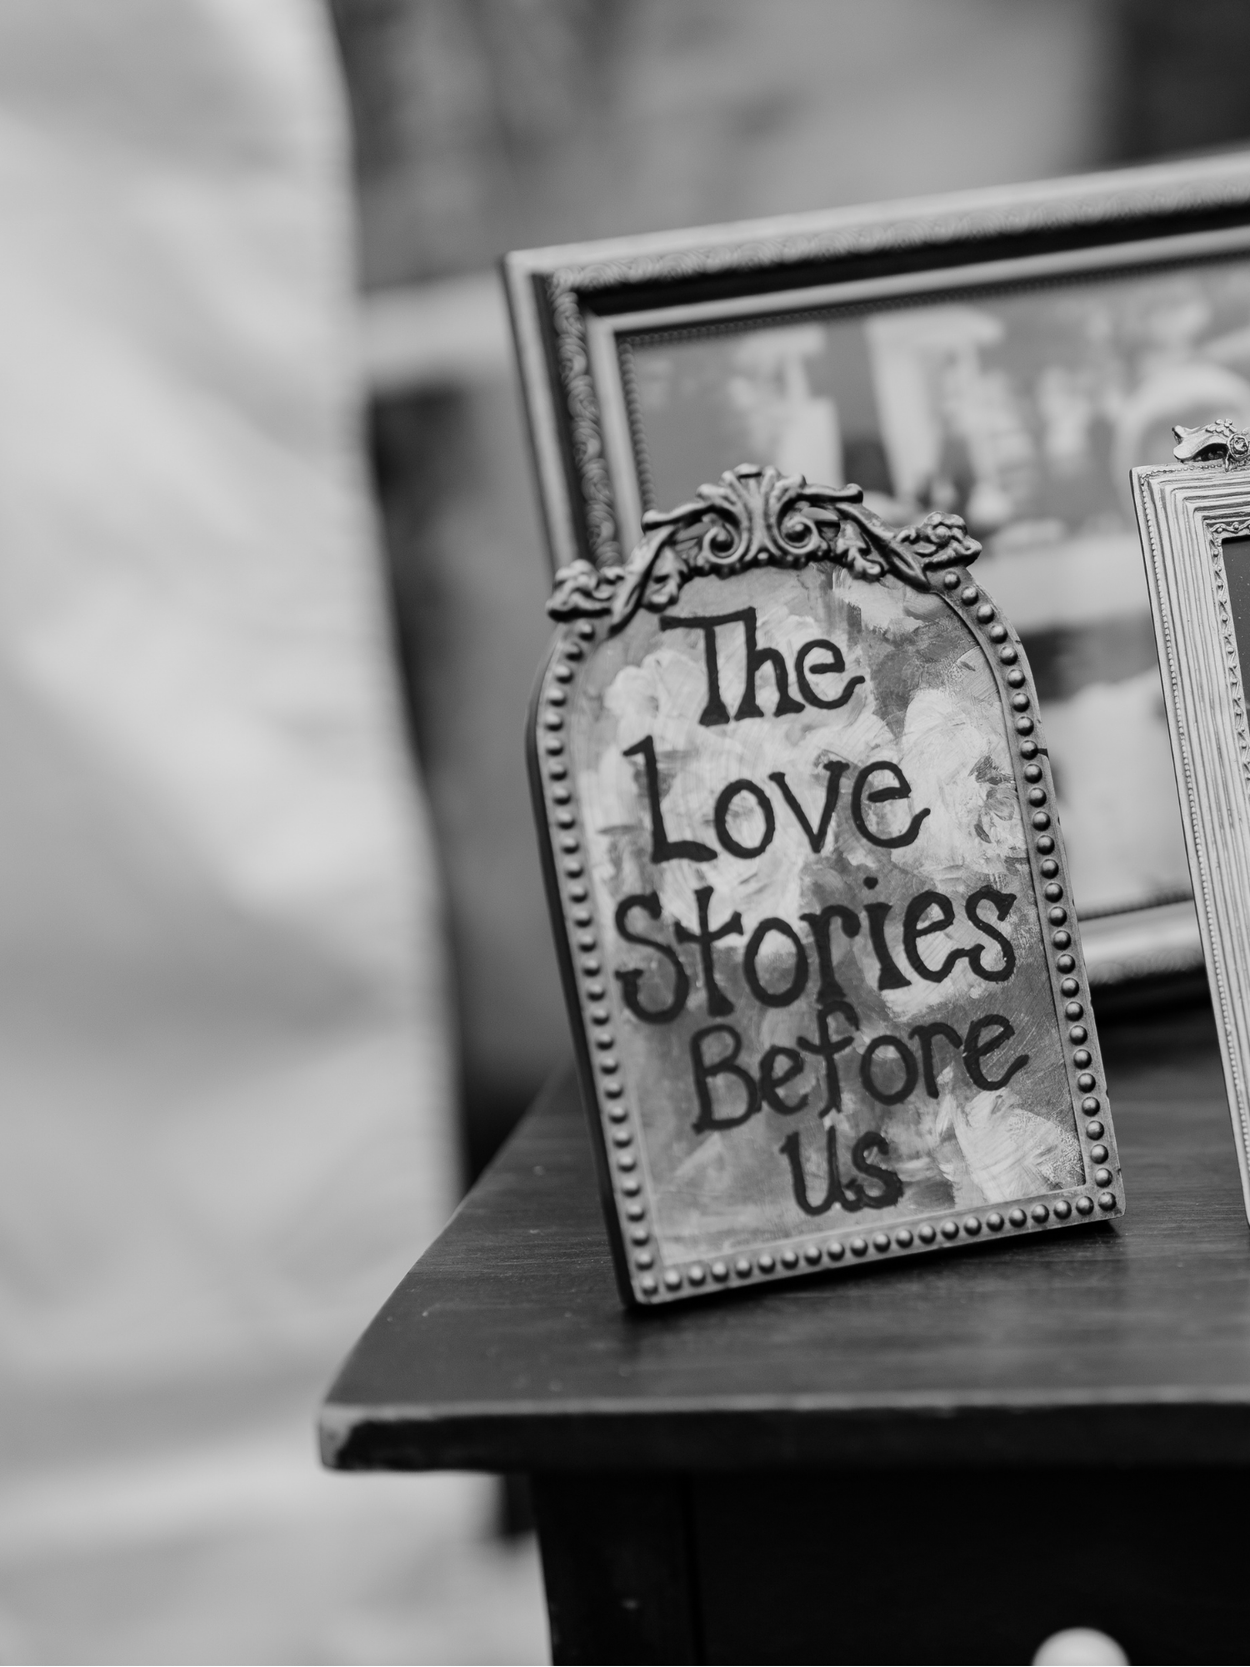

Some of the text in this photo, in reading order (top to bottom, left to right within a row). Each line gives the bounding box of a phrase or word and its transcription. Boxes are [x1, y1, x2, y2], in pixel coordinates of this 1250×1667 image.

[659, 606, 866, 727] The
[622, 735, 931, 864] Love
[614, 876, 1017, 1025] Stories
[690, 1001, 1030, 1135] Before
